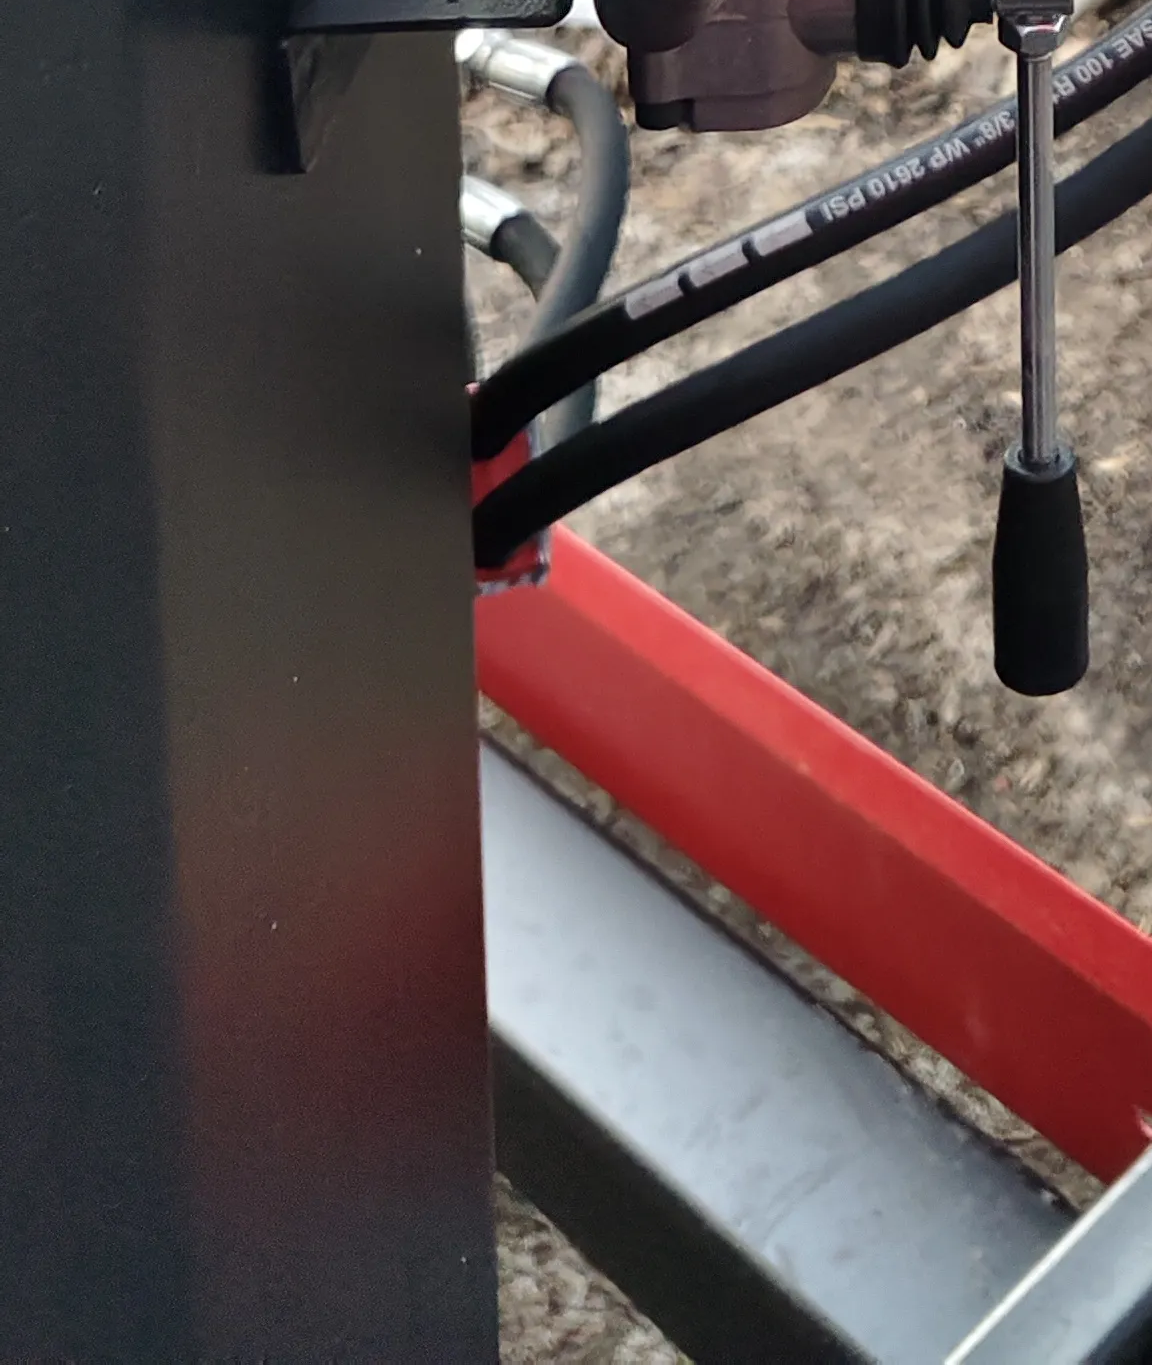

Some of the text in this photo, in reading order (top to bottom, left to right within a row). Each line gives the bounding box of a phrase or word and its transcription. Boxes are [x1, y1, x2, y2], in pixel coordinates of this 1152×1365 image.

[1076, 51, 1115, 84] 100
[928, 136, 971, 171] WP
[866, 156, 926, 198] 2610
[819, 188, 867, 223] PSI
